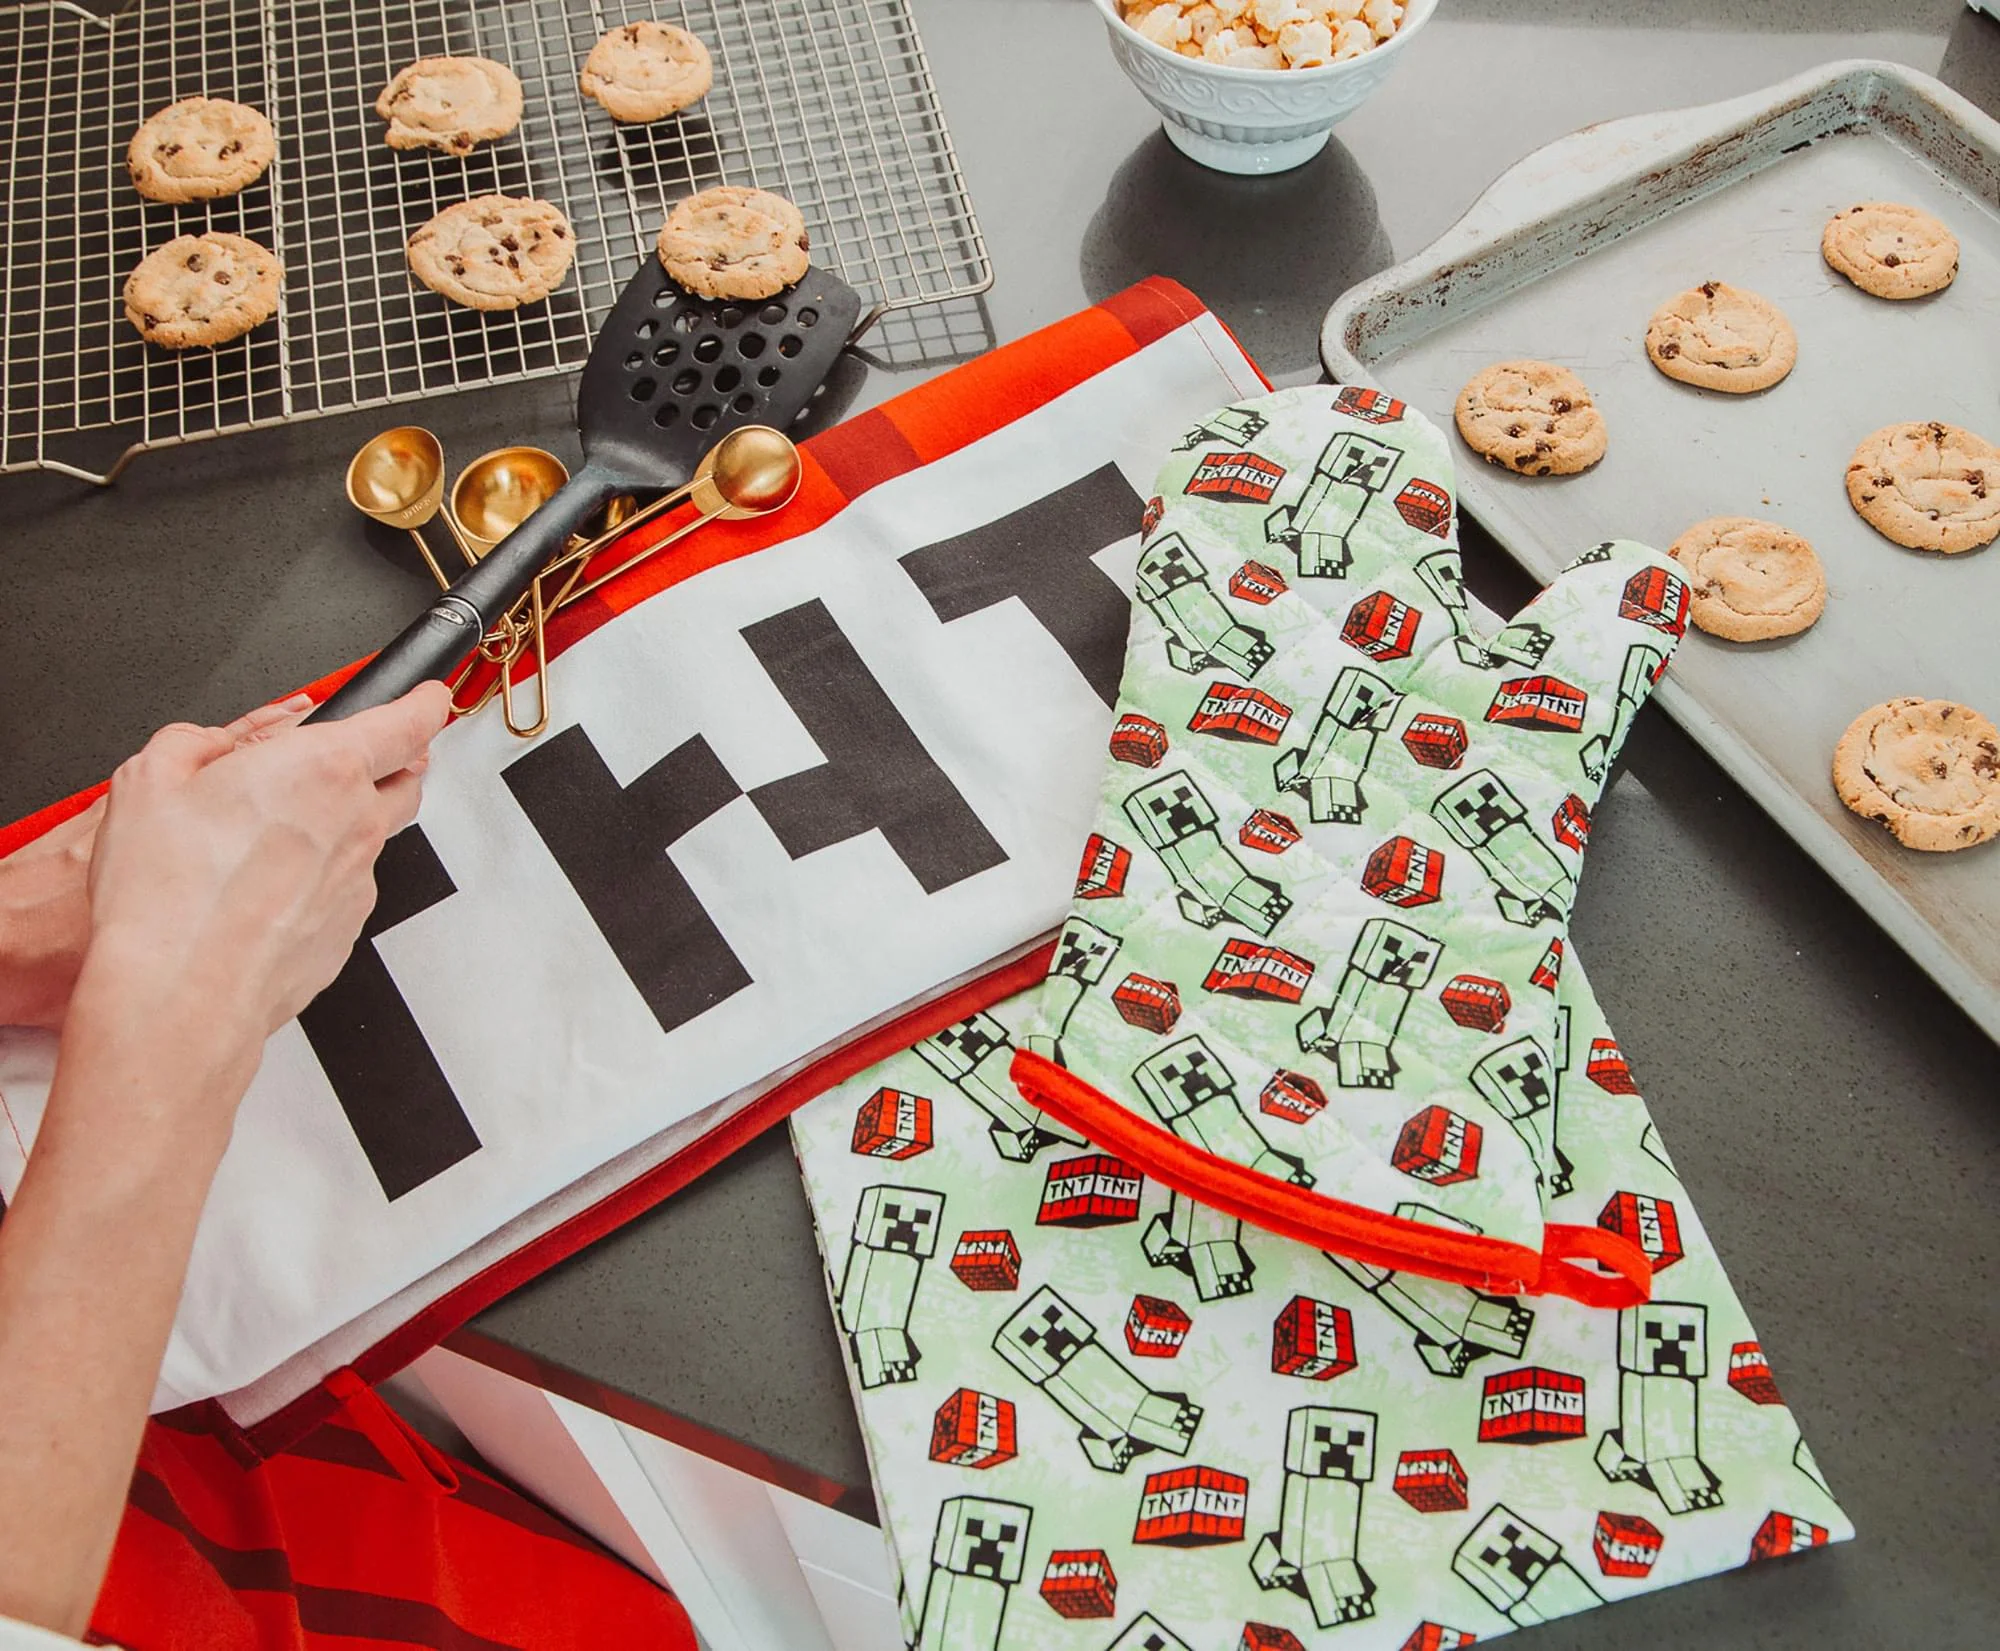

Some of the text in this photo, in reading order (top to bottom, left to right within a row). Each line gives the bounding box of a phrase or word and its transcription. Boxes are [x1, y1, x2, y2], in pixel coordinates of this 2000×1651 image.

[1202, 465, 1275, 486] TNT TNT
[1409, 487, 1443, 502] TNT
[1247, 581, 1275, 598] TNT
[1664, 577, 1682, 613] TNT
[1384, 602, 1408, 638] TNT
[1207, 700, 1283, 724] TNT TNT
[1502, 694, 1582, 716] TNT TNT
[1121, 722, 1155, 737] TNT
[1415, 722, 1450, 734] TNT
[1258, 829, 1288, 847] TNT
[1095, 845, 1115, 877] TNT
[1408, 846, 1428, 883] TNT
[1223, 956, 1305, 983] TNT TNT
[1128, 982, 1167, 998] TNT
[1457, 982, 1496, 996] TNT
[899, 1099, 914, 1132] TNT
[1281, 1096, 1312, 1115] TNT
[1443, 1118, 1461, 1158] TNT
[1050, 1177, 1137, 1199] TNT TNT
[1640, 1202, 1659, 1245] TNT
[964, 1242, 1002, 1254] TNT
[1145, 1330, 1180, 1344] TNT
[1317, 1308, 1335, 1352] TNT
[1487, 1391, 1580, 1415] TNT TNT
[979, 1399, 996, 1441] TNT
[1404, 1460, 1443, 1474] TNT
[1147, 1491, 1240, 1514] TNT TNT
[1617, 1547, 1653, 1563] TNT
[1055, 1563, 1095, 1577] TNT
